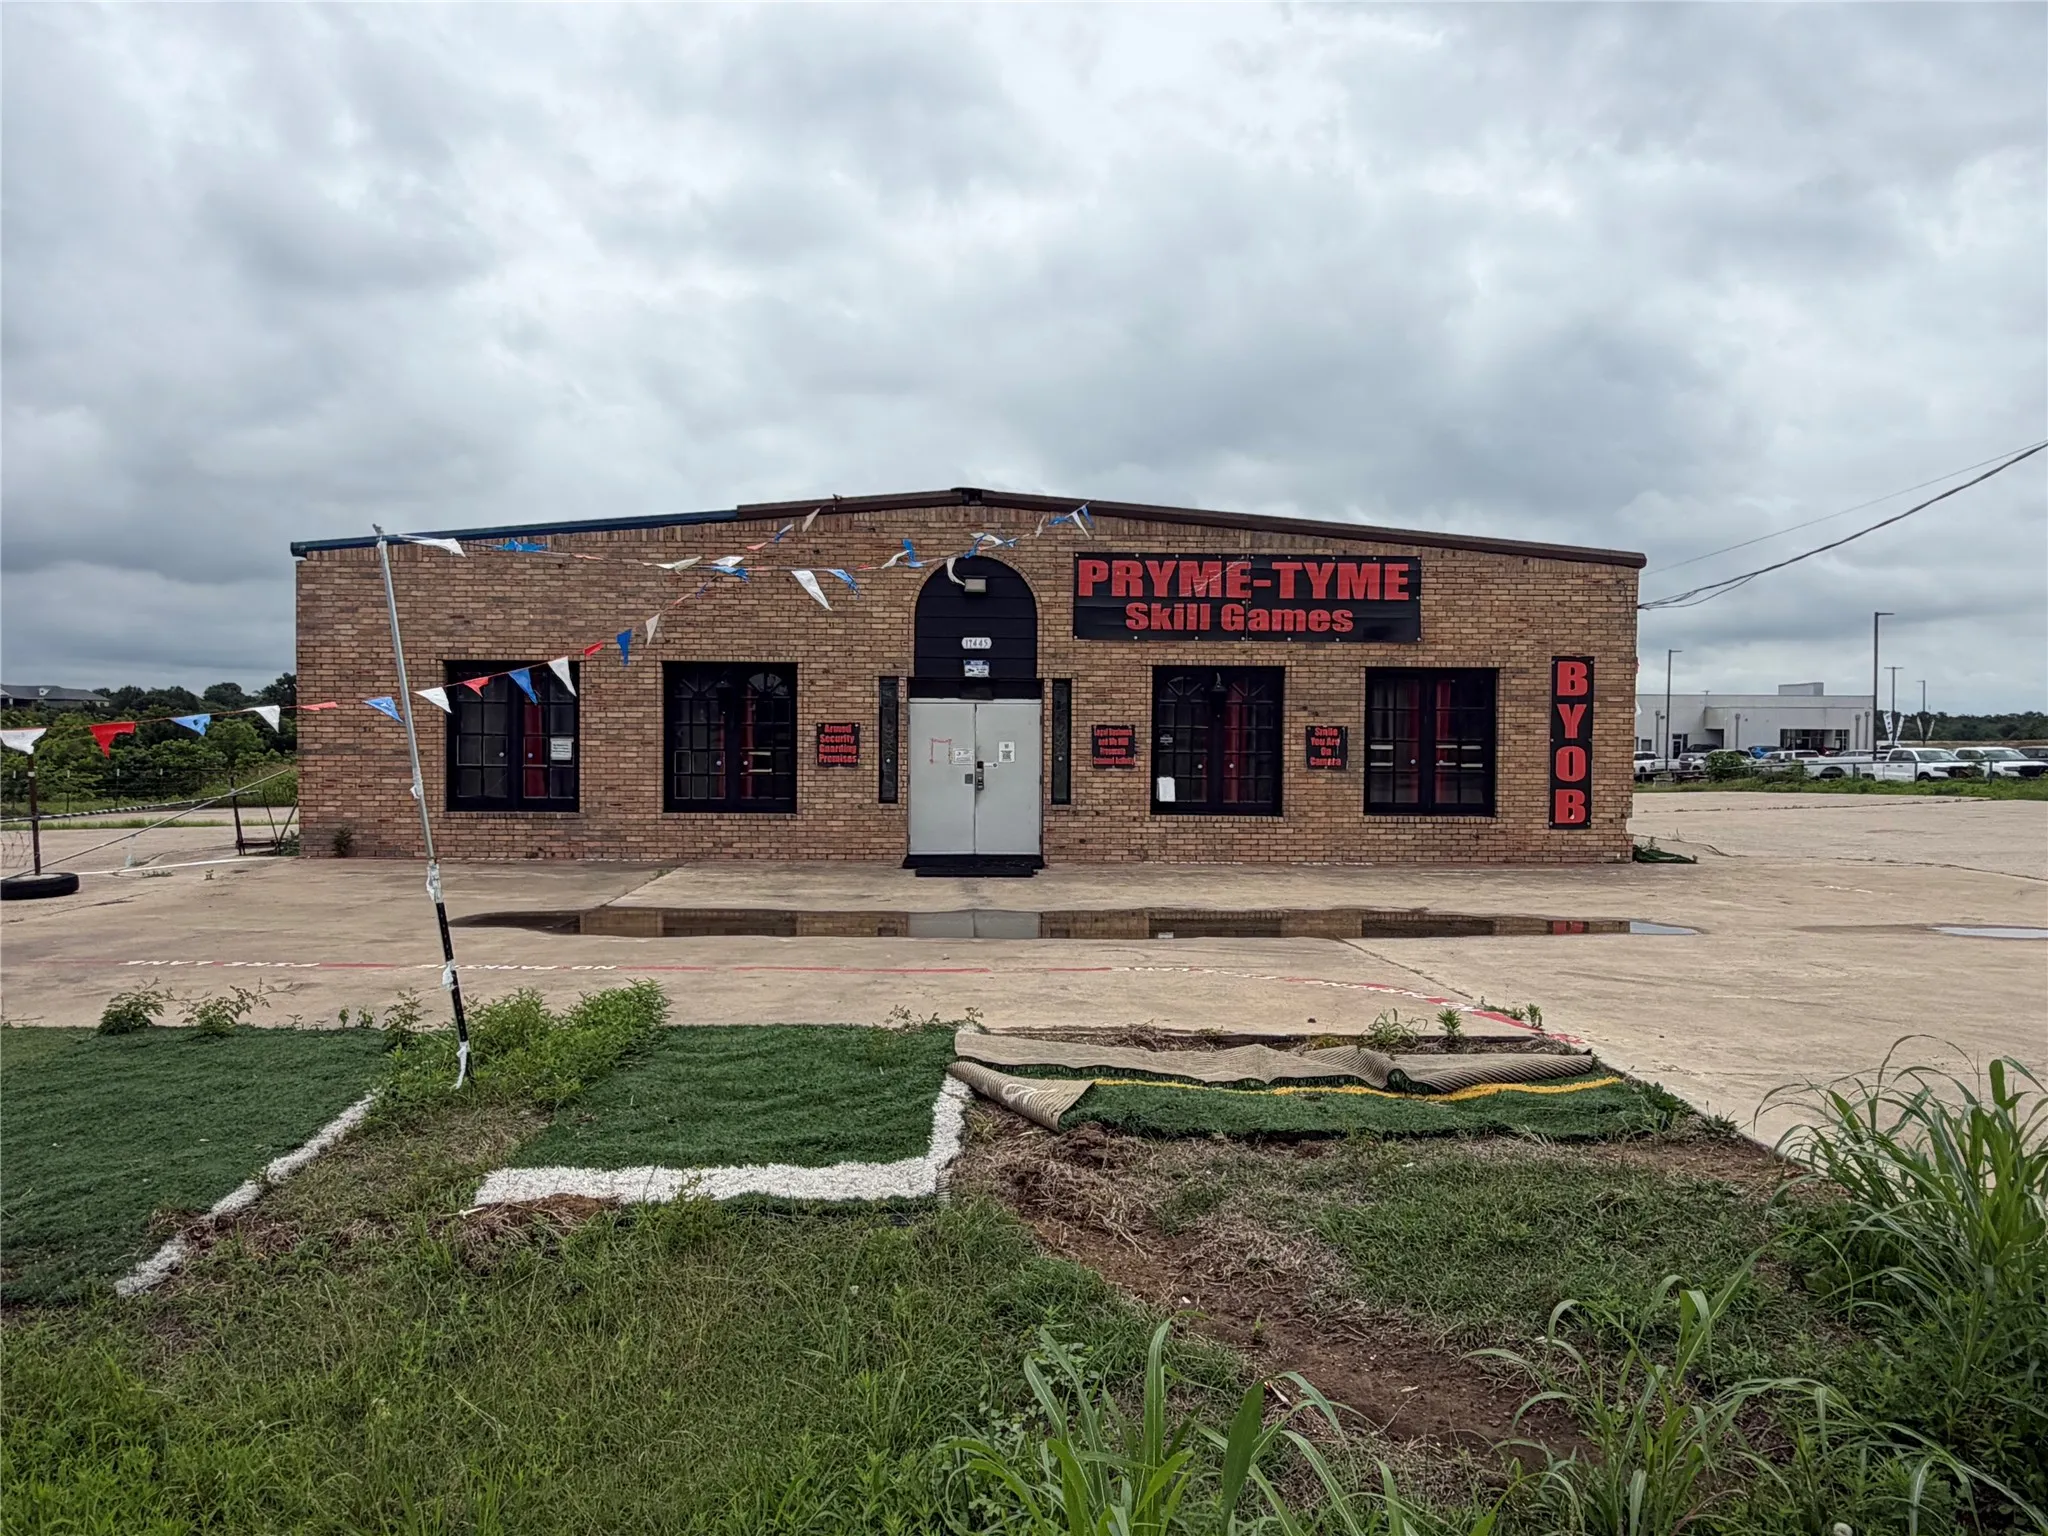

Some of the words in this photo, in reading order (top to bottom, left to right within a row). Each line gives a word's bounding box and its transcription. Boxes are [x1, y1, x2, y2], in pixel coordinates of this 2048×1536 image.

[1078, 559, 1409, 601] PRYME-TYME
[1125, 602, 1210, 631] Skill
[1221, 603, 1354, 632] Games
[1314, 726, 1338, 736] Smile
[820, 733, 855, 744] Security
[1310, 737, 1325, 746] You
[1326, 737, 1340, 746] Are
[1554, 660, 1589, 824] BYOB
[819, 743, 857, 754] Guarding
[1320, 746, 1332, 756] On
[818, 753, 857, 763] Premises
[1309, 756, 1342, 766] Camera
